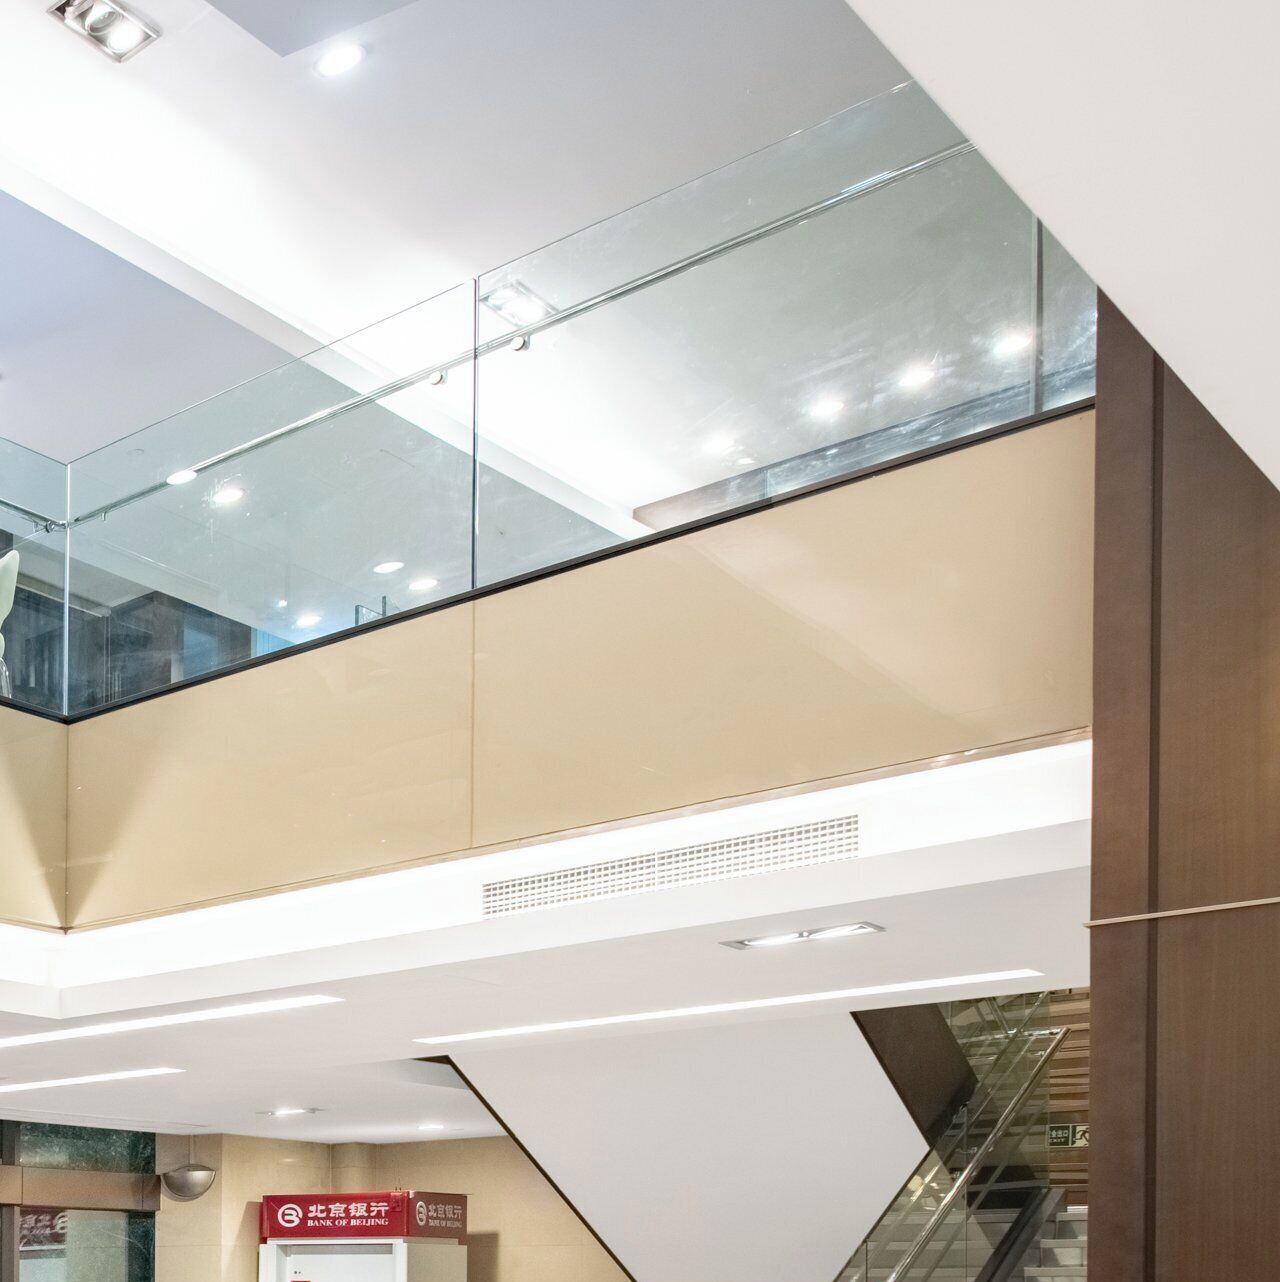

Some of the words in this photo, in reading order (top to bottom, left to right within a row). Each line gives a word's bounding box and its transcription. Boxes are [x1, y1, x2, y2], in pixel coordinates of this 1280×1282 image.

[307, 1203, 389, 1218] 北京银行
[307, 1219, 333, 1227] BANK
[335, 1219, 348, 1227] OF
[350, 1218, 389, 1227] BEIJING
